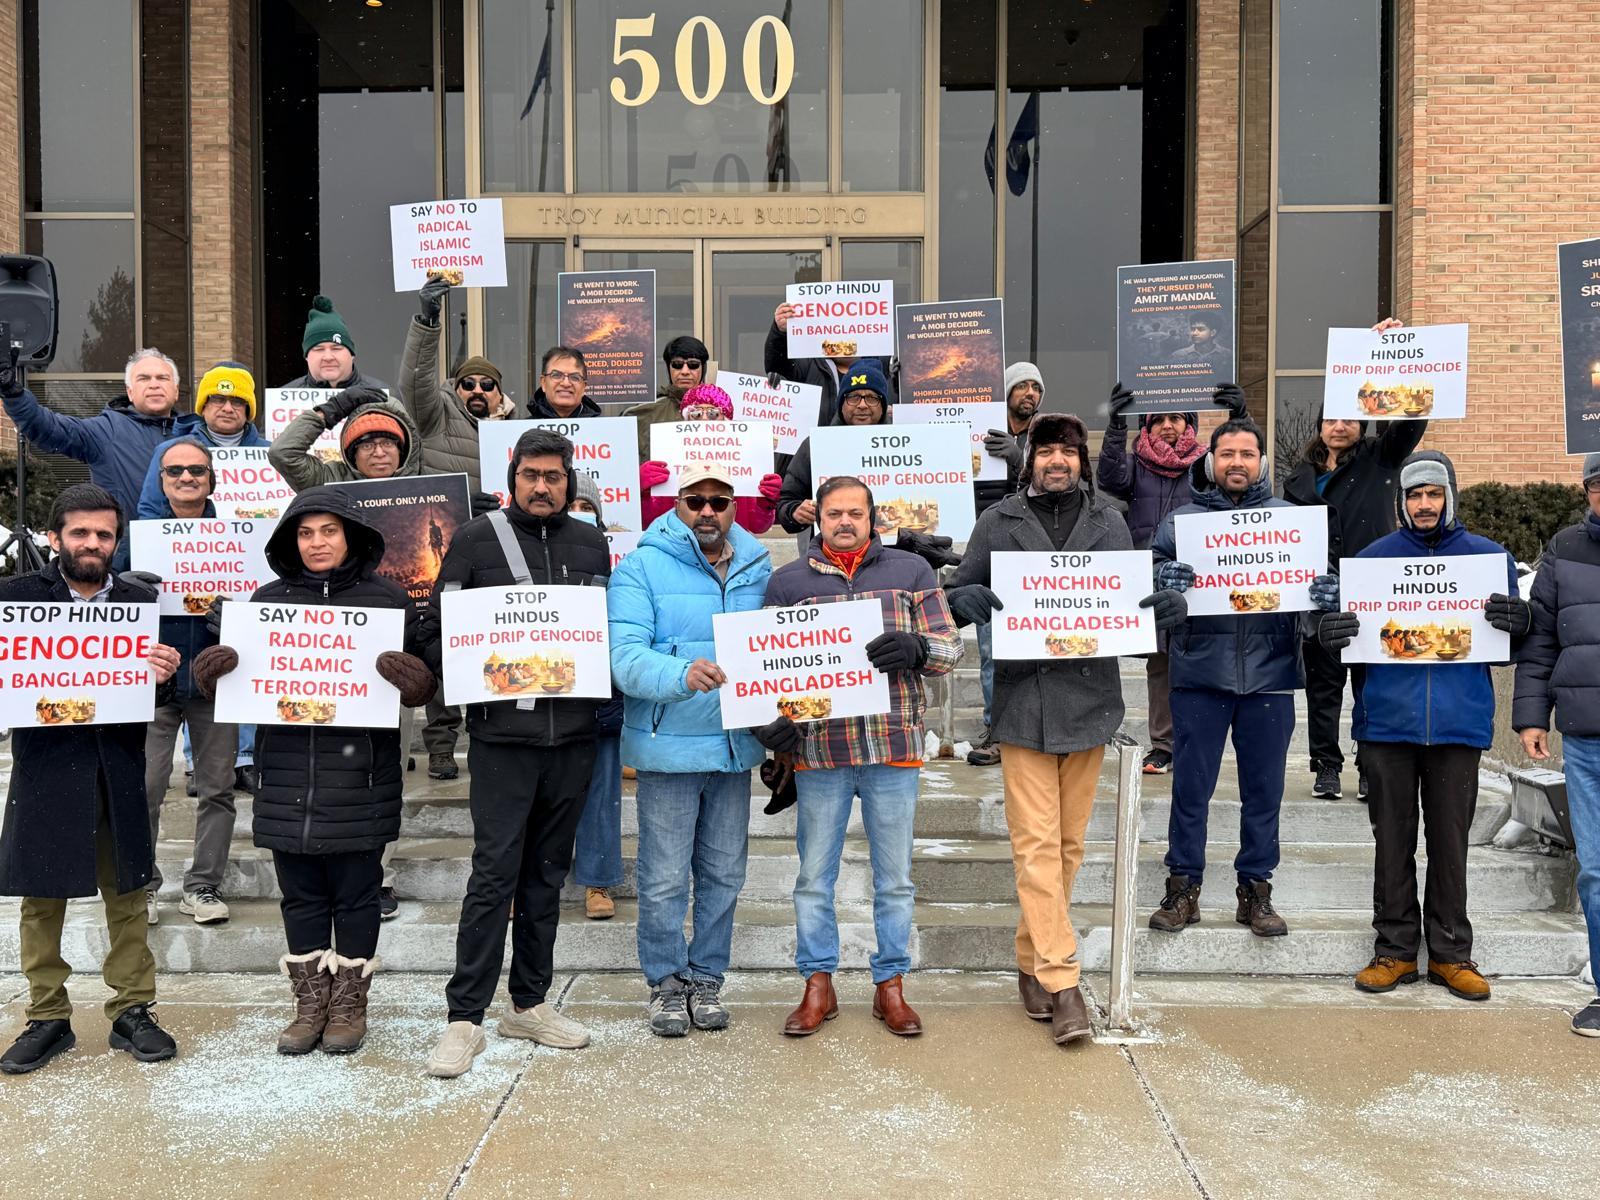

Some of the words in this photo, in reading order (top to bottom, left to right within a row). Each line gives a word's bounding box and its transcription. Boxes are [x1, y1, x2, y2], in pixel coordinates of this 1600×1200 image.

[610, 13, 795, 106] 500
[411, 205, 432, 217] SAY
[436, 203, 455, 215] NO
[459, 202, 477, 214] TO
[537, 207, 602, 225] TROY
[613, 207, 744, 225] MUNICIPAL
[754, 207, 866, 225] BUILDING
[417, 220, 472, 234] RADICAL
[420, 237, 471, 251] ISLAMIC
[411, 255, 483, 269] TERRORISM
[798, 284, 832, 295] STOP
[836, 283, 881, 294] HINDU
[1159, 284, 1195, 292] PURSUED
[1135, 294, 1168, 305] AMRIT
[1171, 292, 1216, 302] MANDAL
[793, 301, 889, 318] GENOCIDE
[924, 313, 947, 321] WENT
[960, 310, 985, 318] WORK.
[792, 325, 803, 335] in
[807, 323, 888, 335] BANGLADESH
[947, 321, 978, 329] DECIDED
[917, 331, 950, 339] WOULDN'T
[1381, 332, 1416, 344] STOP
[1371, 348, 1424, 360] HINDUS
[611, 359, 643, 367] DOUSED
[1332, 365, 1362, 374] DRIP
[1365, 365, 1395, 375] DRIP
[1398, 361, 1462, 374] GENOCIDE
[738, 376, 761, 387] SAY
[785, 383, 801, 394] TO
[851, 374, 867, 386] M
[280, 390, 320, 401] STOP
[742, 391, 793, 409] RADICAL
[742, 407, 790, 422] ISLAMIC
[935, 407, 965, 417] STOP
[675, 424, 701, 433] SAY
[705, 423, 726, 433] NO
[730, 423, 748, 432] TO
[683, 437, 742, 447] RADICAL
[871, 435, 911, 449] STOP
[685, 451, 741, 461] ISLAMIC
[861, 454, 923, 468] HINDUS
[894, 471, 967, 486] GENOCIDE
[213, 489, 295, 502] BANGLADE
[363, 498, 395, 508] COURT.
[396, 496, 418, 506] ONLY
[419, 496, 425, 504] A
[426, 494, 449, 504] MOB.
[1231, 511, 1272, 525] STOP
[162, 522, 194, 535] SAY
[200, 521, 226, 534] NO
[231, 521, 253, 534] TO
[1205, 529, 1301, 549] LYNCHING
[172, 541, 246, 554] RADICAL
[1050, 555, 1092, 568] STOP
[1217, 552, 1273, 566] HINDUS
[1278, 551, 1291, 563] in
[175, 561, 244, 574] ISLAMIC
[1404, 563, 1446, 576] STOP
[1022, 575, 1121, 590] LYNCHING
[1194, 569, 1316, 589] BANGLADESH
[160, 580, 258, 593] TERRORISM
[1393, 581, 1458, 595] HINDUS
[505, 591, 547, 605] STOP
[1034, 598, 1092, 609] HINDUS
[1097, 597, 1110, 608] in
[1348, 601, 1382, 612] DRIP
[1387, 600, 1422, 612] DRIP
[1427, 599, 1490, 611] GENOCI
[3, 605, 61, 623] STOP
[69, 606, 140, 623] HINDU
[259, 607, 297, 623] SAY
[304, 609, 335, 625] NO
[341, 611, 368, 626] TO
[495, 610, 560, 625] HINDUS
[776, 608, 819, 625] STOP
[1007, 615, 1139, 631] BANGLADESH
[269, 631, 357, 650] RADICAL
[450, 633, 485, 648] DRIP
[490, 630, 525, 645] DRIP
[530, 629, 604, 643] GENOCIDE
[749, 626, 852, 652] LYNCHING
[0, 635, 150, 661] GENOCIDE
[270, 656, 353, 673] ISLAMIC
[763, 654, 823, 671] HINDUS
[828, 652, 841, 665] in
[12, 670, 148, 689] BANGLADESH
[736, 669, 873, 698] BANGLADESH
[251, 679, 368, 697] TERRORISM
